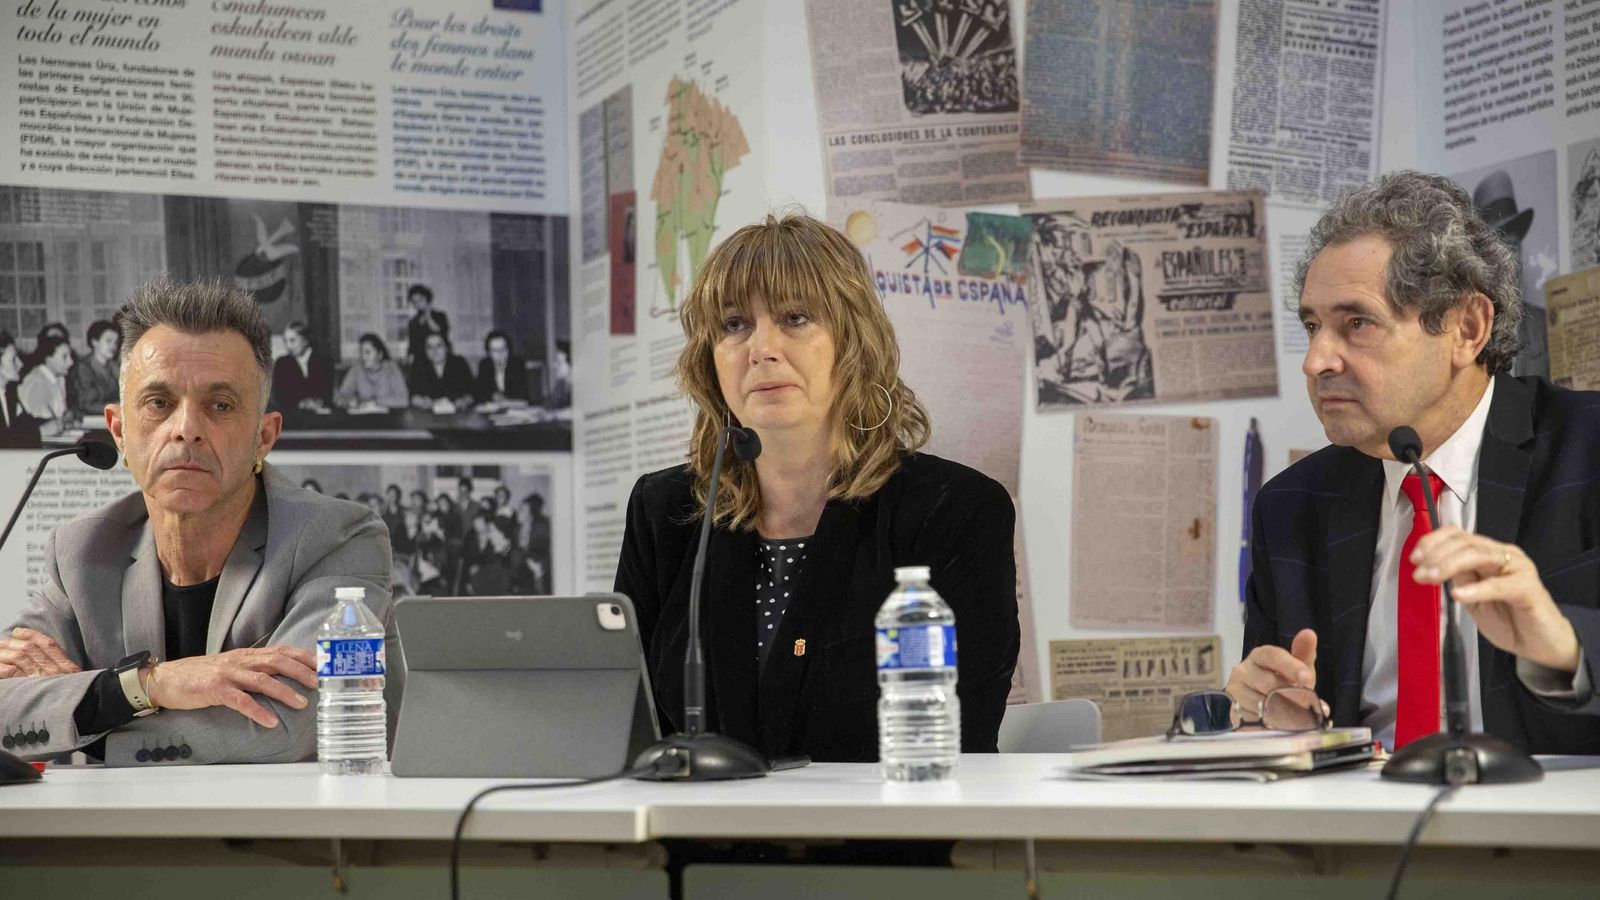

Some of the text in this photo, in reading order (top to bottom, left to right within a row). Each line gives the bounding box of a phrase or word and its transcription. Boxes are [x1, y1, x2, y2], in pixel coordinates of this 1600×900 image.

[17, 0, 160, 32] de la mujer en
[17, 25, 160, 51] todo el mundo
[318, 25, 359, 46] alde
[828, 123, 1019, 147] LAS CONCLUSIONES DE LA CONFERENCIA
[876, 270, 937, 309] QUISTA
[335, 641, 374, 653] ELENA
